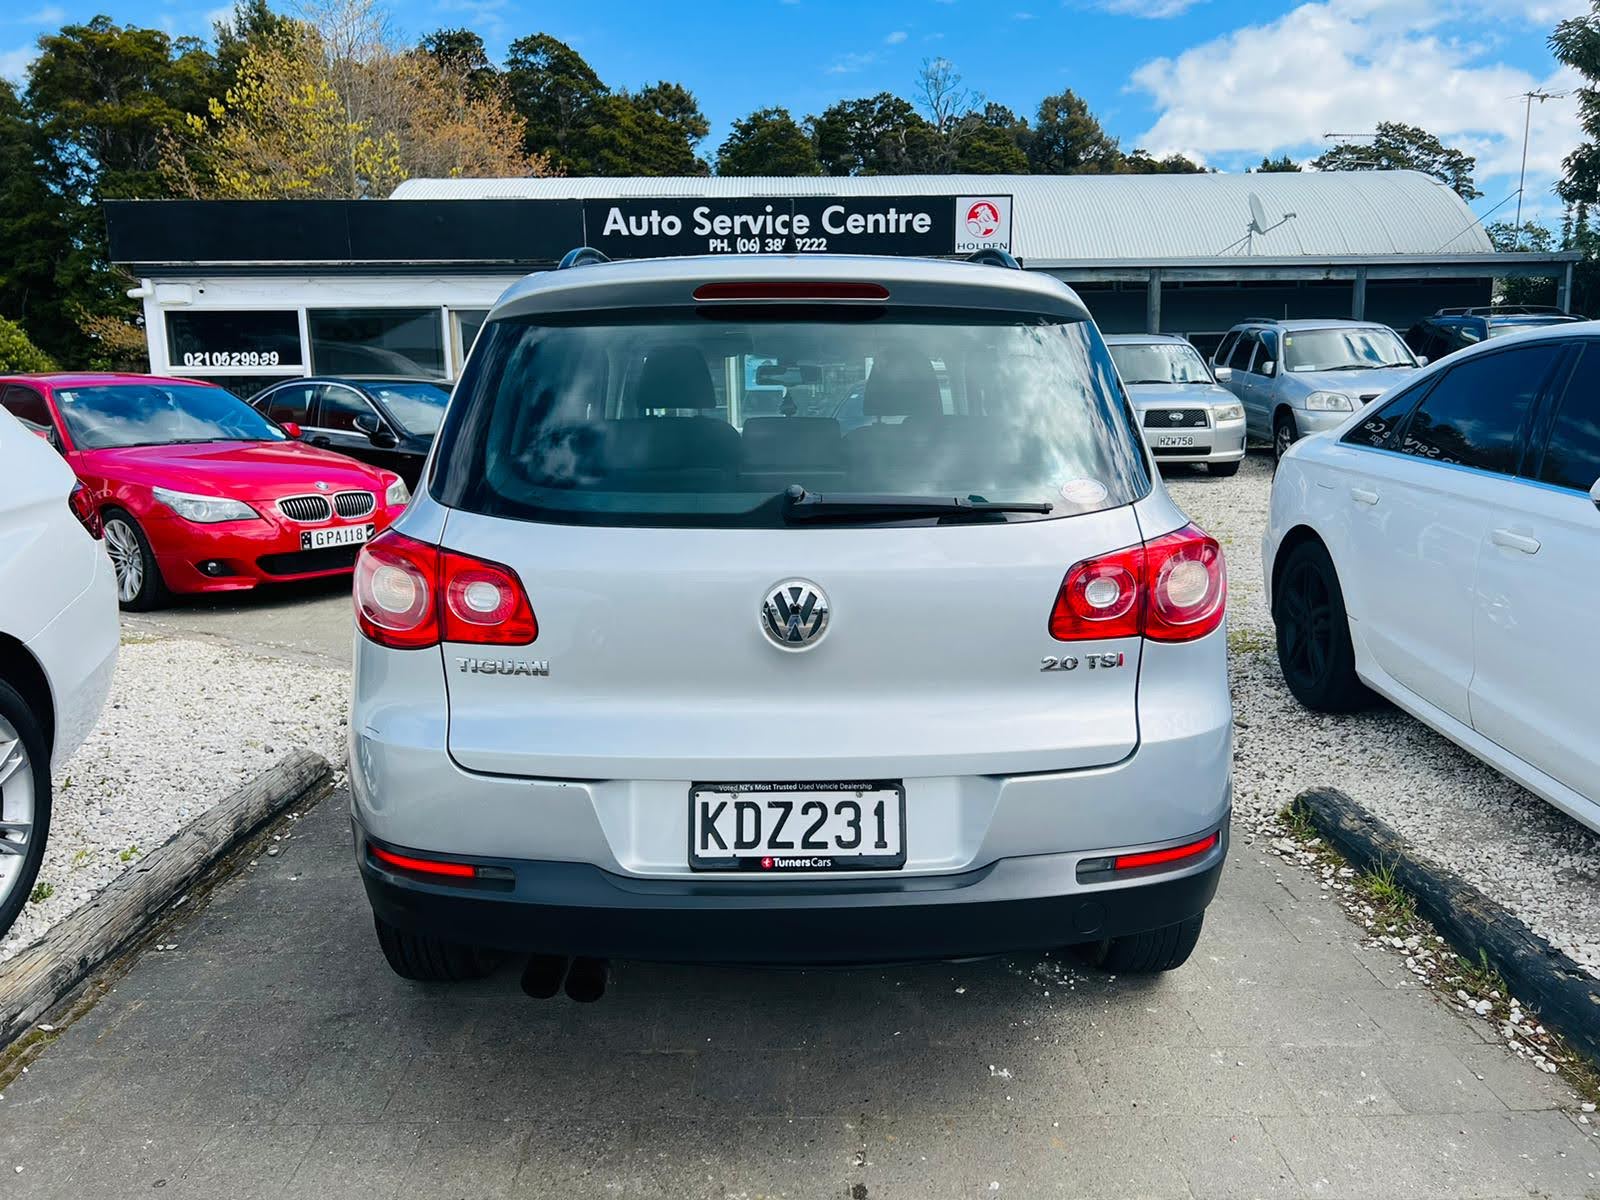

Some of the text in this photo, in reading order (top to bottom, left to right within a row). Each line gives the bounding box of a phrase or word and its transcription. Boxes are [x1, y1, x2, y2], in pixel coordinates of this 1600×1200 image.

[603, 204, 932, 236] Auto Service Centre
[709, 238, 731, 252] PH.
[736, 237, 760, 253] (06)
[795, 238, 827, 251] 9222
[957, 242, 1008, 250] HOLDEN
[1160, 436, 1194, 446] HZW758
[316, 528, 363, 546] GPA118
[456, 657, 550, 676] TIGUAN
[1084, 652, 1125, 670] TSI
[772, 783, 798, 791] Trusted
[839, 782, 873, 791] Dealership
[700, 800, 888, 850] KDZ231
